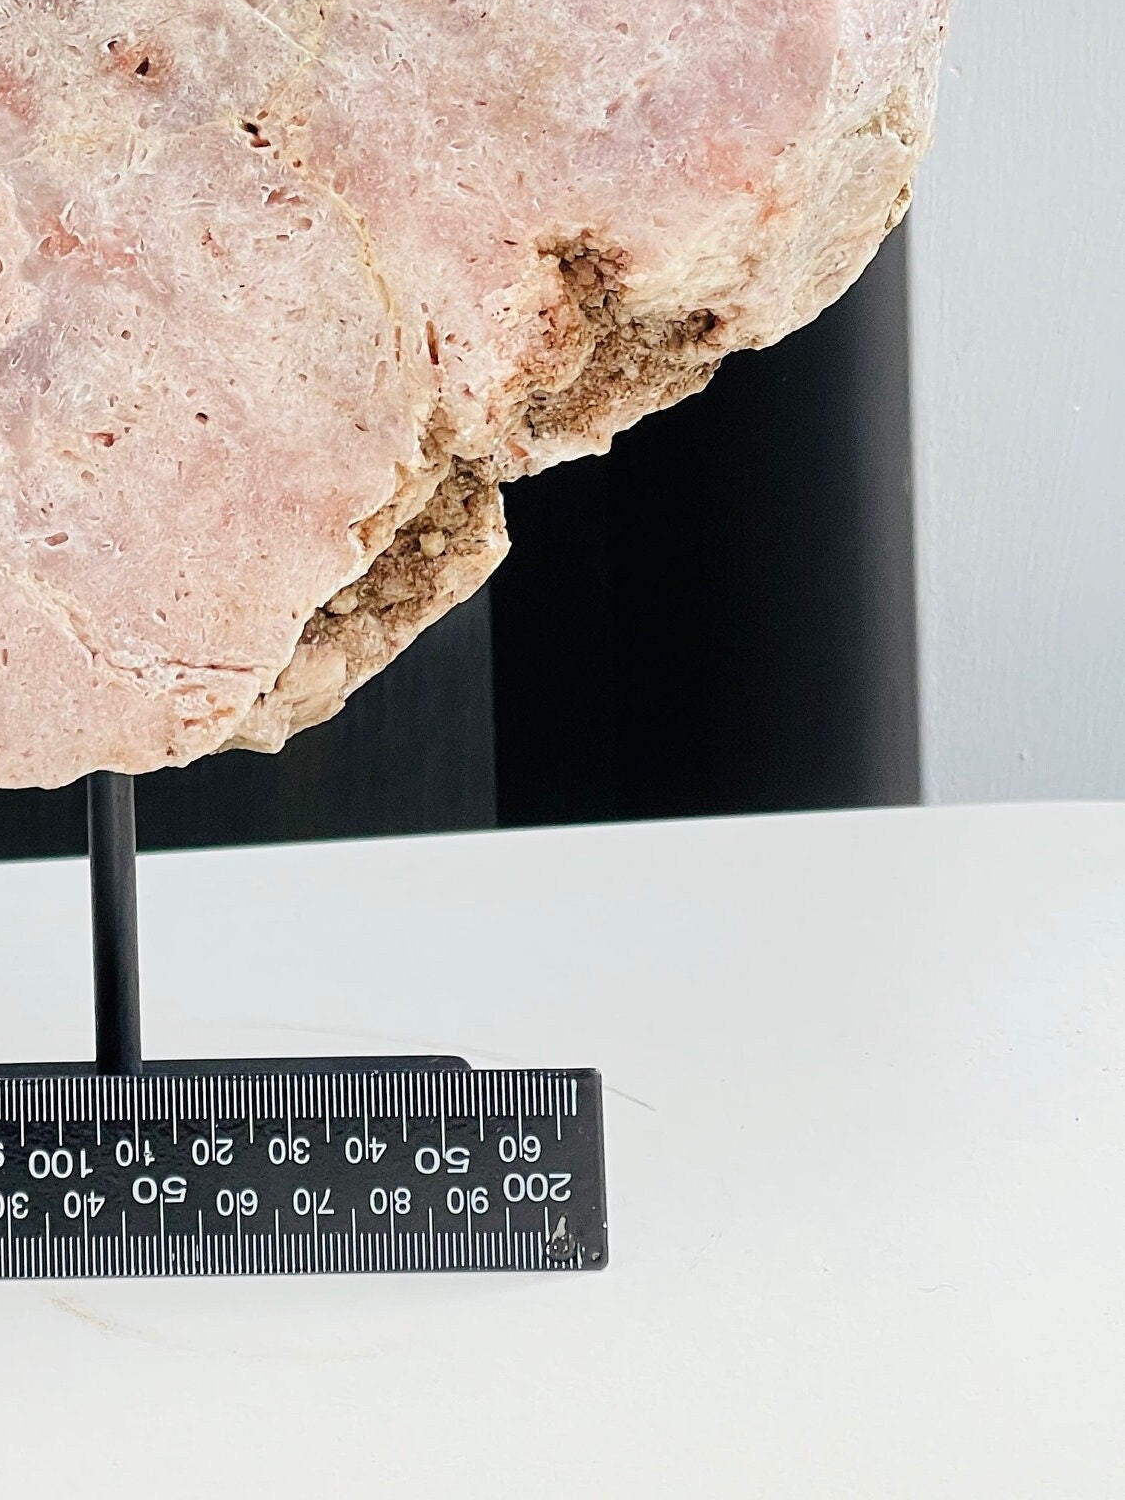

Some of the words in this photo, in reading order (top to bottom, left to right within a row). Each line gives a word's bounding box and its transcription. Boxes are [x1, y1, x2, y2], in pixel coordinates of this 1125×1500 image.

[115, 1138, 155, 1165] 10
[191, 1138, 234, 1166] 20
[268, 1136, 311, 1165] 30
[344, 1135, 387, 1165] 40
[416, 1146, 471, 1176] 50
[499, 1134, 541, 1162] 60
[29, 1148, 94, 1180] 100
[132, 1174, 188, 1205] 50
[293, 1187, 335, 1217] 70
[369, 1187, 411, 1216] 80
[446, 1186, 489, 1214] 90
[503, 1172, 572, 1203] 200
[63, 1190, 105, 1219] 40
[215, 1188, 258, 1217] 60
